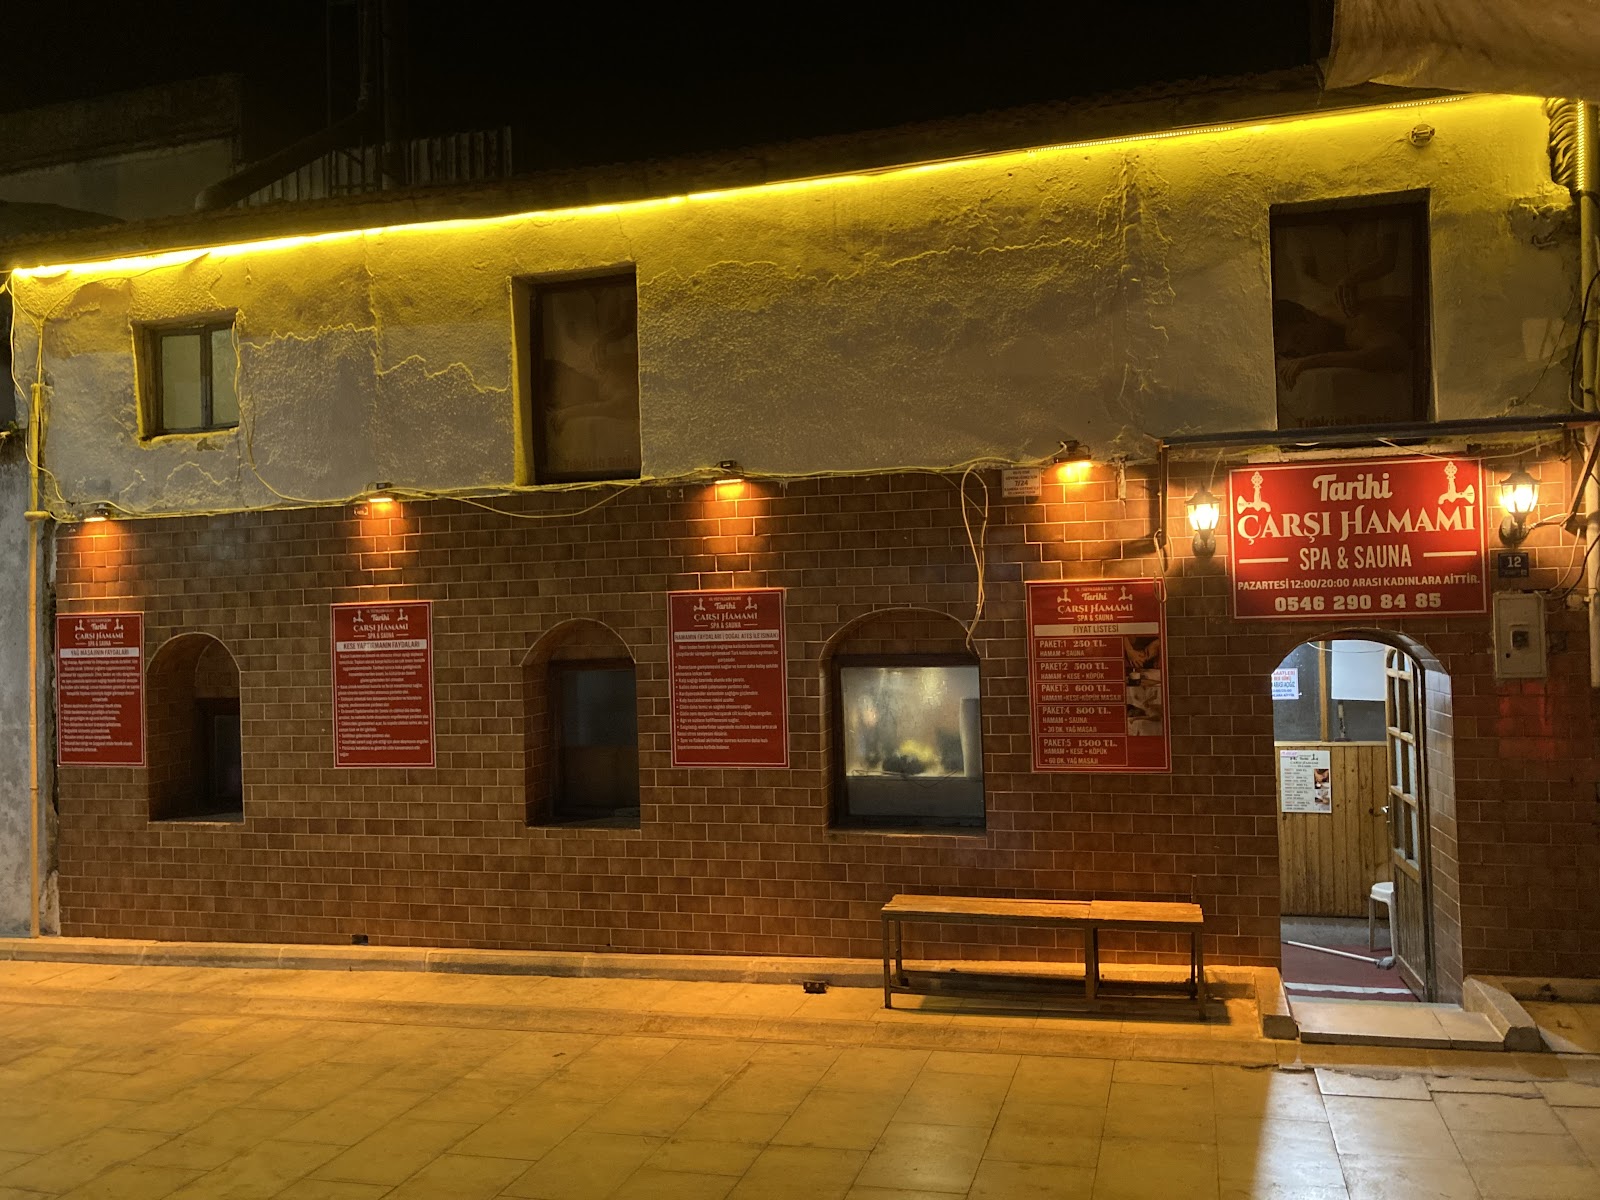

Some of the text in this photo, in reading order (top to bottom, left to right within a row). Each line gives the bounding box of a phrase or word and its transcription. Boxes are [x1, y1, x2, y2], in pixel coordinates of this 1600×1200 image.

[1312, 472, 1393, 502] Tarihi
[1237, 504, 1475, 545] ÇARŞI HAMAMI
[1300, 544, 1412, 571] SPA & SAUNA
[1508, 556, 1521, 568] 12
[1238, 572, 1480, 590] PAZARTESİ 12:00/20:00 ARASI KADINLARA AİTTİR.
[1082, 592, 1108, 601] Tarihi
[1274, 592, 1442, 612] 0546 290 84 85
[714, 602, 736, 610] Tarihi
[1058, 603, 1133, 614] ÇARŞI HAMAMI
[694, 612, 758, 622] ÇARŞI HAMAMI
[1093, 624, 1119, 632] LİSTESİ
